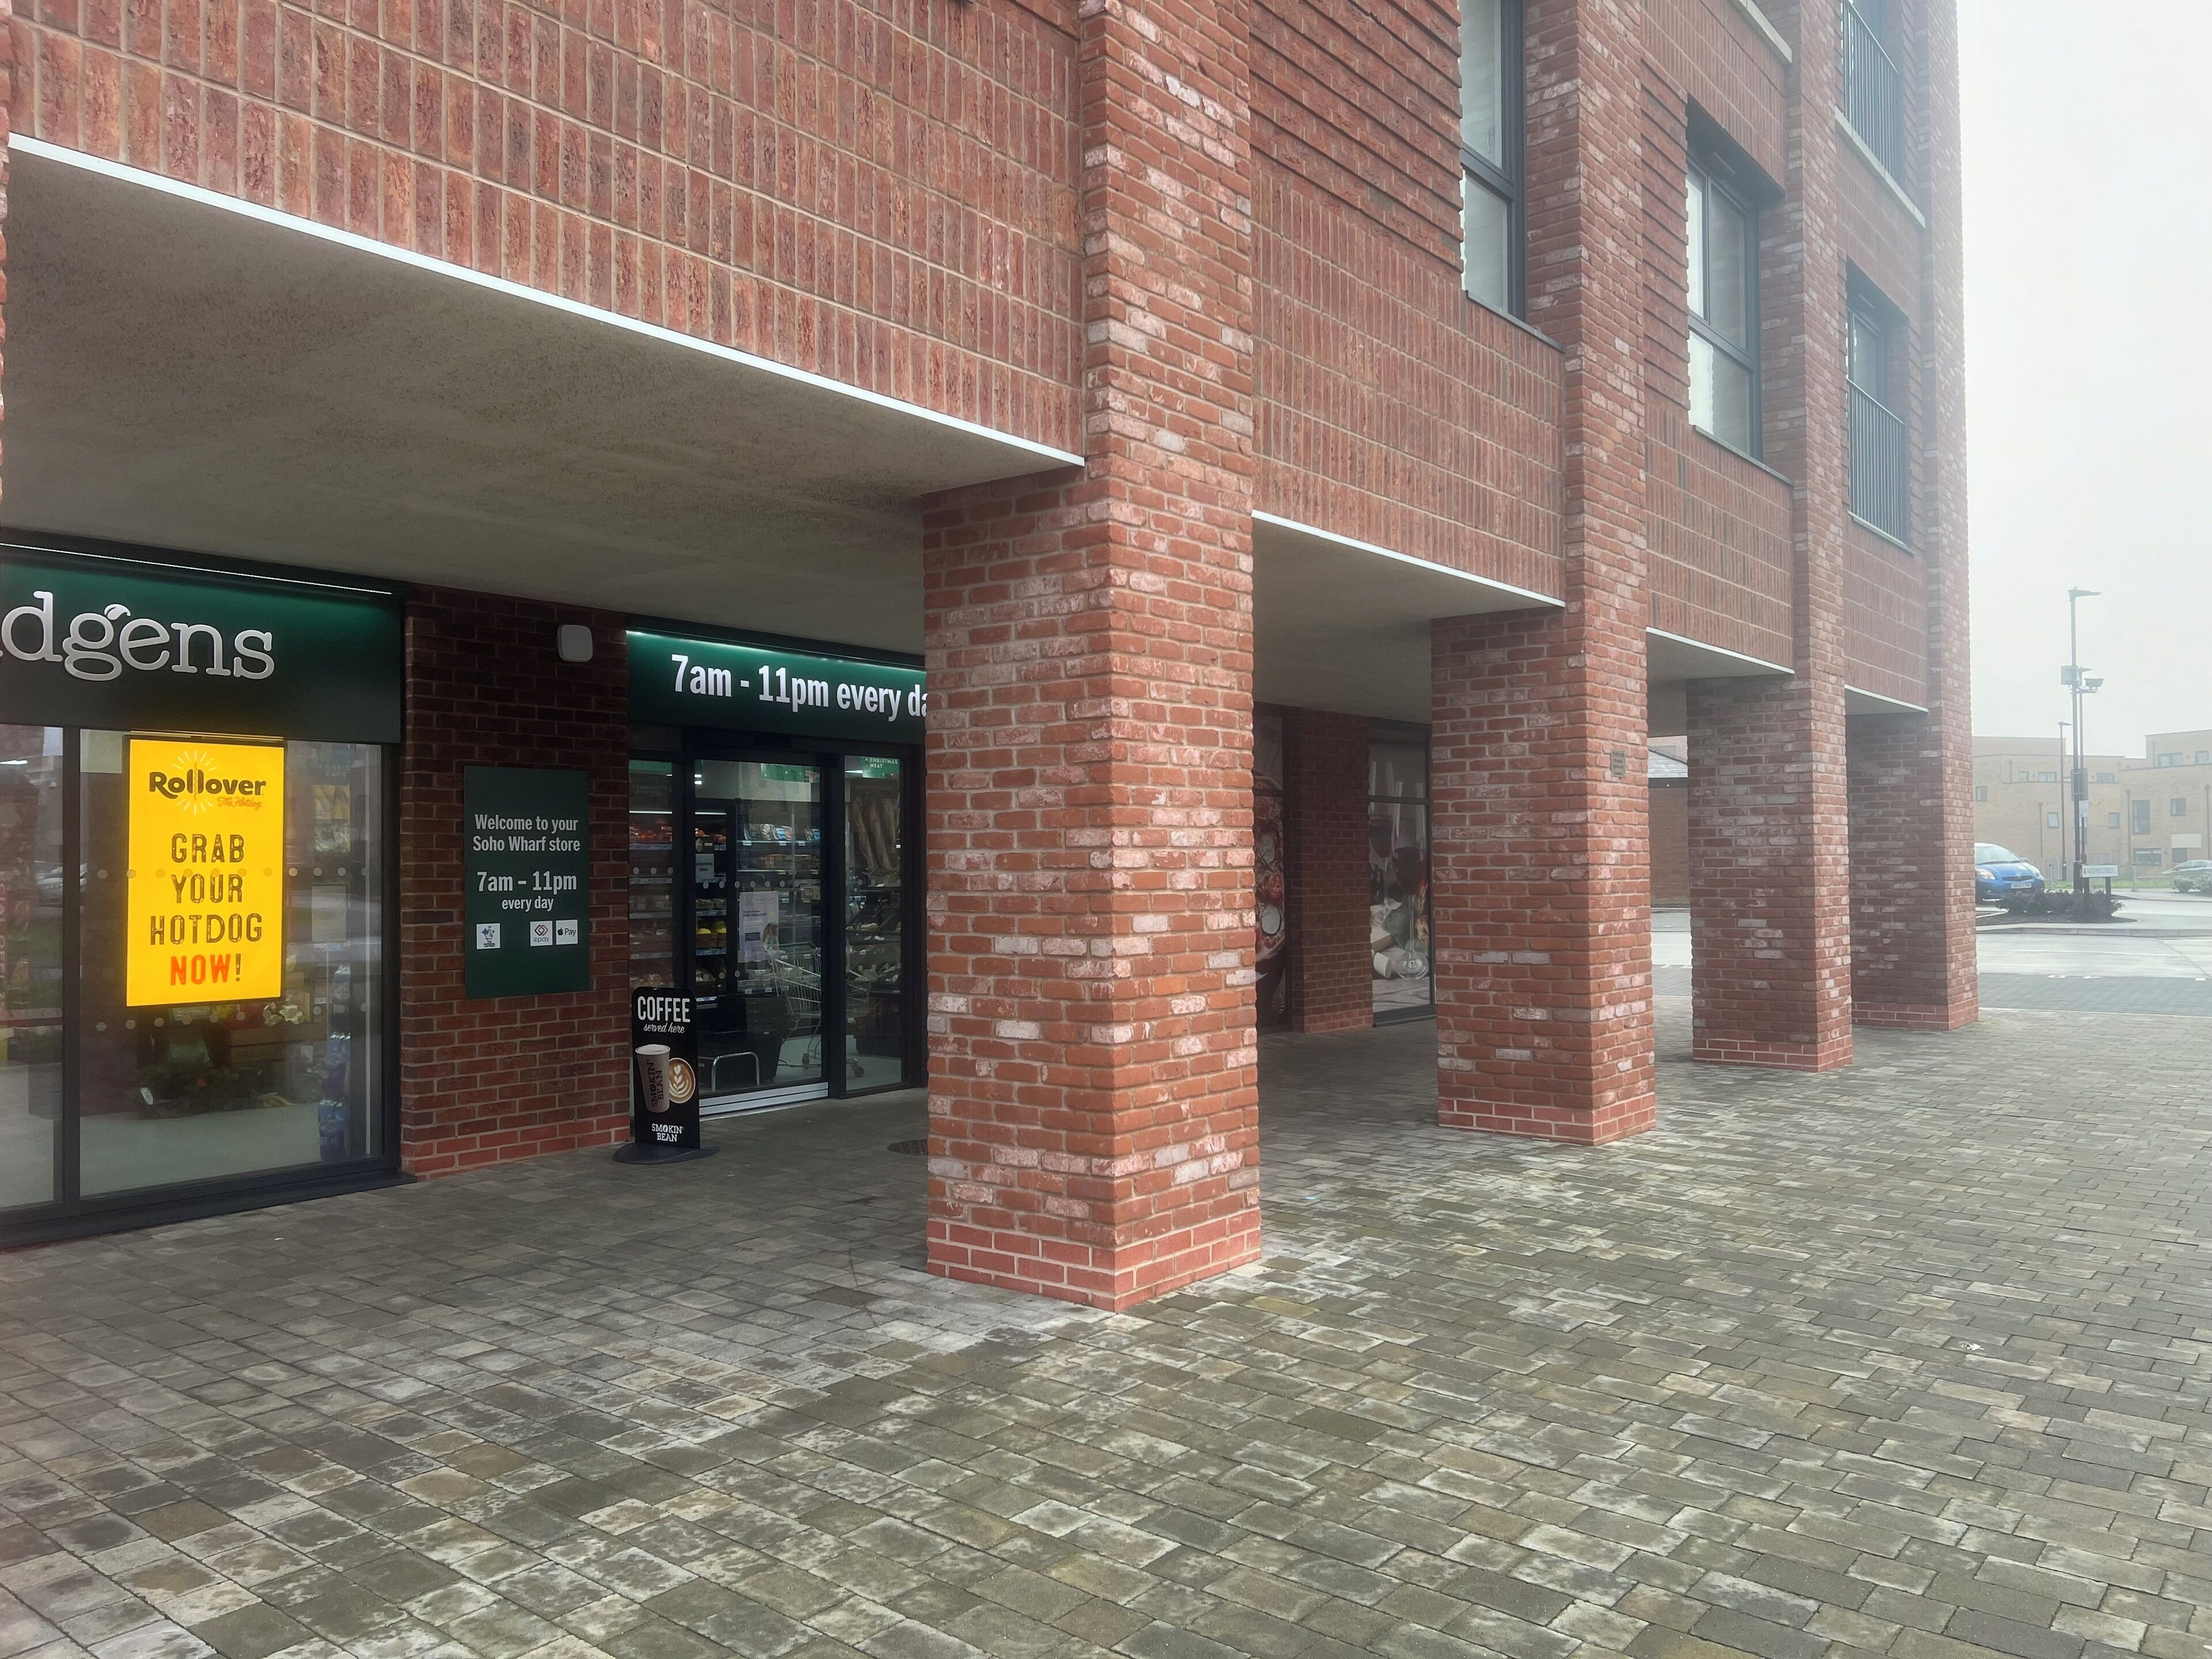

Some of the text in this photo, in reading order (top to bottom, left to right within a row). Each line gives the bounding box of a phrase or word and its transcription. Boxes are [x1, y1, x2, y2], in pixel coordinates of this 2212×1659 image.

[0, 590, 275, 681] dgens
[672, 654, 732, 698] 7am
[740, 679, 749, 688] -
[758, 665, 828, 713] 11pm
[836, 682, 902, 722] every
[149, 769, 266, 799] Rollover
[217, 796, 262, 810] The Hotdog
[475, 814, 578, 834] Welcome to your
[171, 833, 244, 863] GRAB
[472, 835, 581, 852] Soho Wharf store
[171, 873, 243, 903] YOUR
[477, 872, 513, 892] 7am
[532, 871, 577, 895] 11pm
[502, 896, 554, 912] every day
[150, 913, 262, 945] HOTDOG
[565, 927, 577, 937] Pay
[171, 953, 242, 986] NOW!
[637, 996, 691, 1022] COFFEE
[643, 1022, 685, 1033] served here
[657, 1132, 677, 1143] BEAN
